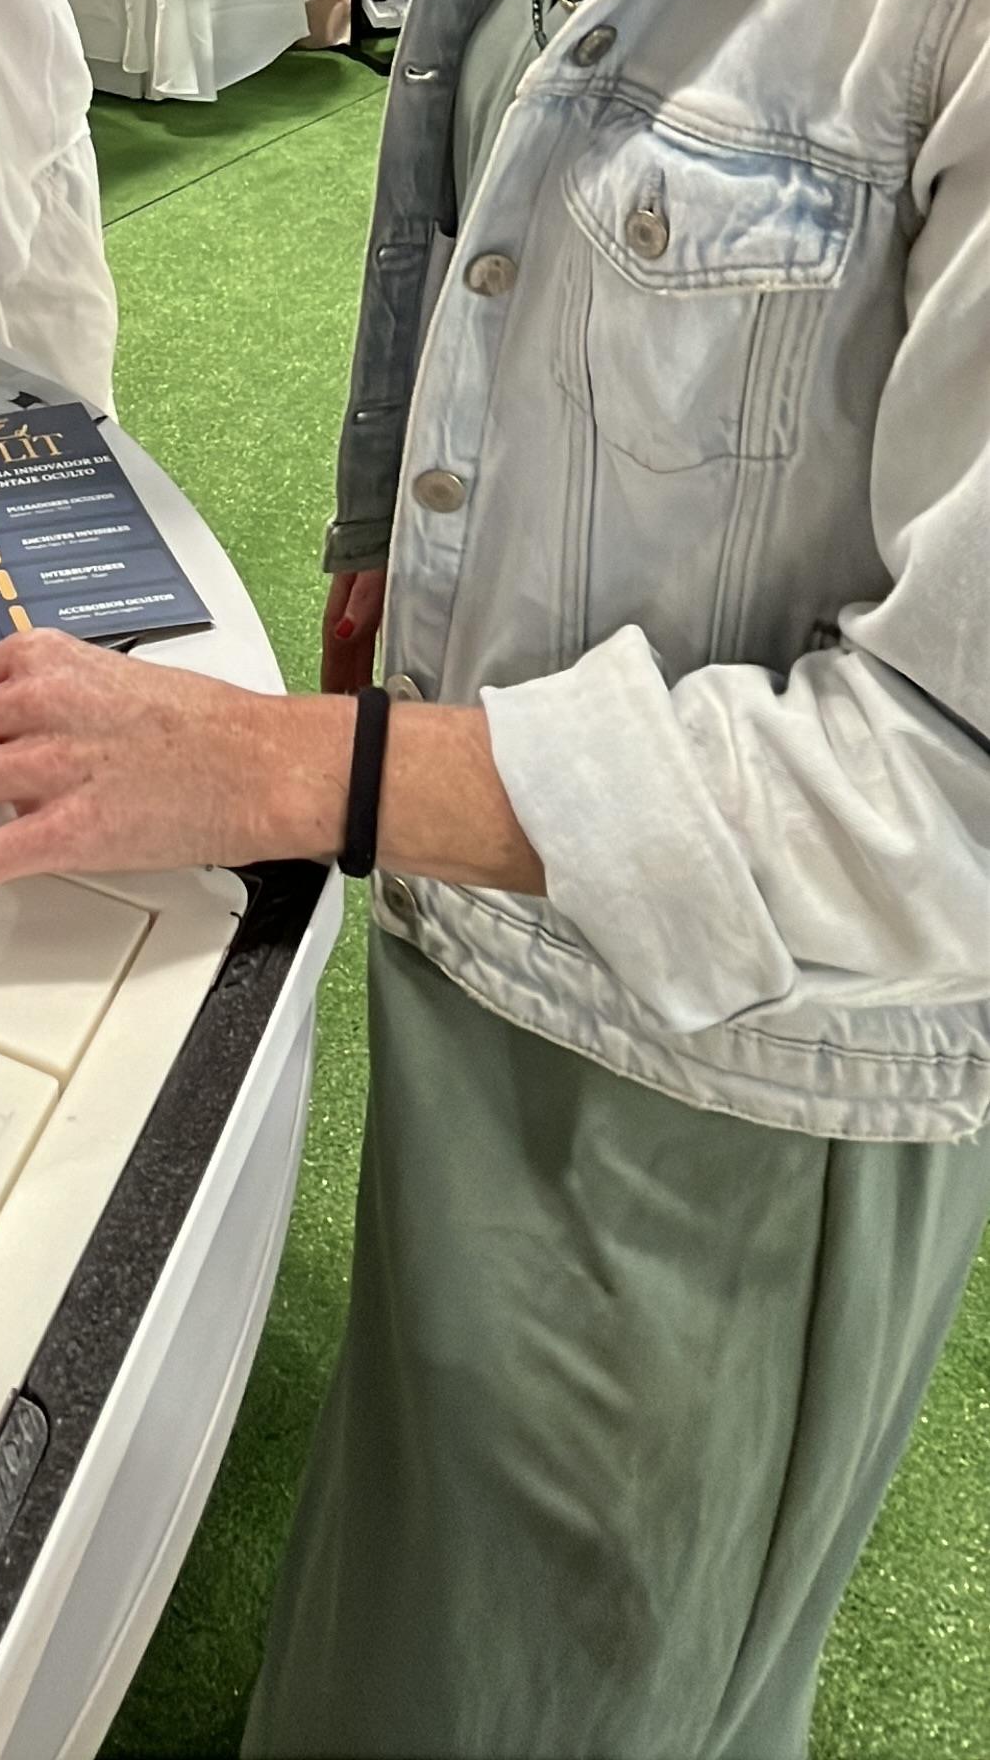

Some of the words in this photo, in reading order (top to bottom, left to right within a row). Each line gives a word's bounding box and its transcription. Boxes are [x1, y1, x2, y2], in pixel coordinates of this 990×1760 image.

[14, 457, 92, 478] INNOVADOR
[94, 455, 113, 464] DE
[42, 467, 96, 483] OCULTO
